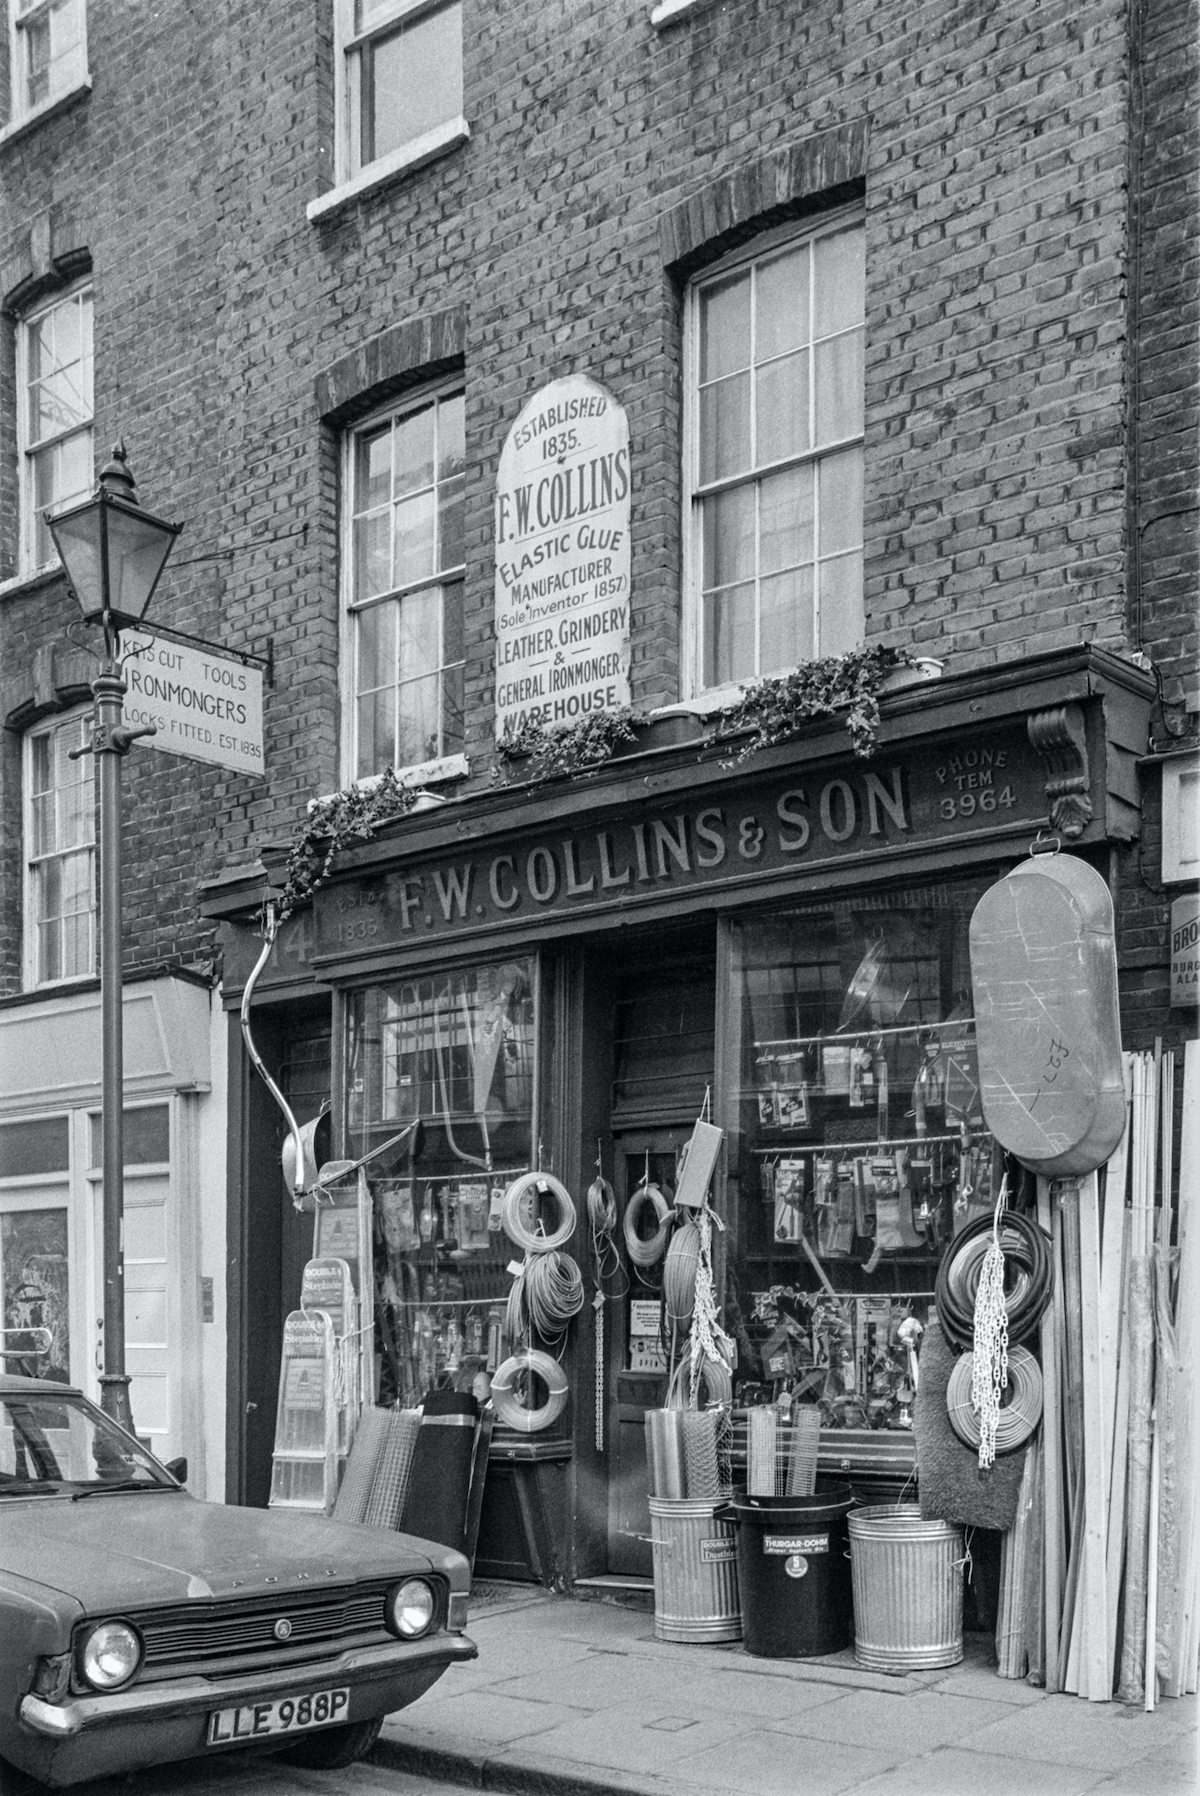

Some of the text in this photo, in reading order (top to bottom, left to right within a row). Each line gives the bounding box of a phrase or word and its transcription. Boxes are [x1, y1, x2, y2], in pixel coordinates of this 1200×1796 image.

[513, 395, 607, 450] ESTABLISHED
[537, 448, 628, 529] COLLINS
[499, 525, 624, 589] ELASTIC GLUE
[511, 557, 612, 606] MANUFACTURER
[528, 591, 589, 621] Inventor
[558, 606, 627, 647] GRINDERY
[123, 638, 247, 691] KEYS CUT TOOLS
[553, 651, 565, 666] &
[125, 667, 247, 725] IRONMONGERS
[498, 673, 545, 708] GENERAL
[124, 706, 166, 730] LOCKS
[936, 750, 1007, 784] PHONE
[954, 769, 993, 791] TEM
[941, 785, 1016, 820] 3964
[489, 806, 728, 910] COLLINS
[738, 815, 765, 859] &
[775, 766, 910, 852] SON
[793, 1555, 800, 1568] 5
